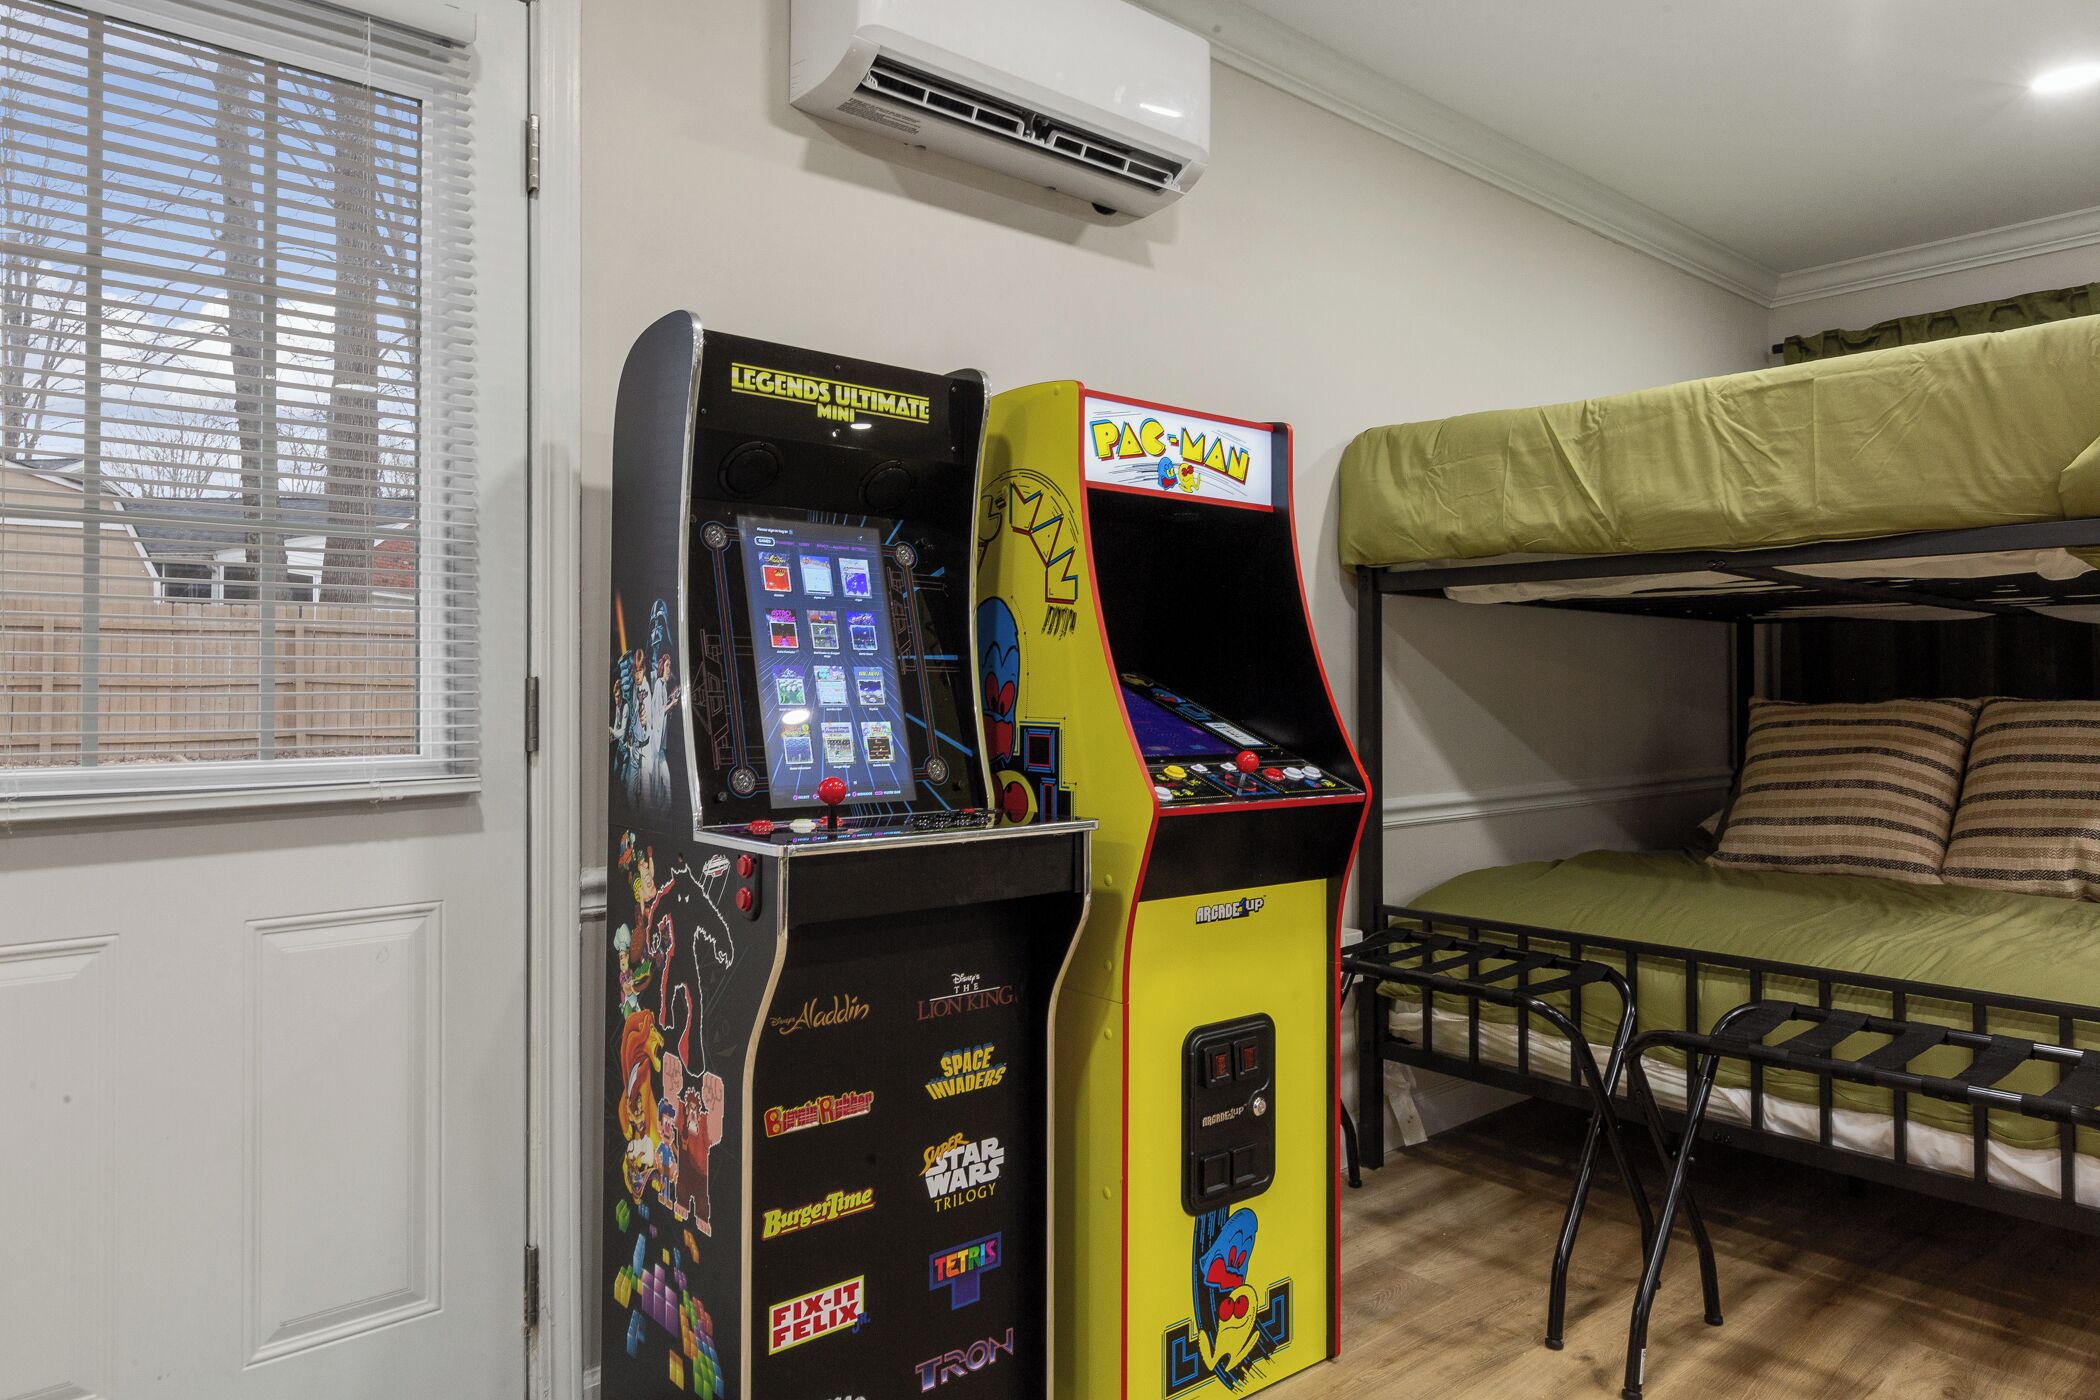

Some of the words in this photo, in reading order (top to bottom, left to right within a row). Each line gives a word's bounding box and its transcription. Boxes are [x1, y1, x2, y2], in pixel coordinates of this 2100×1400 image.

[731, 366, 830, 402] LEGENDS
[835, 384, 930, 421] ULTIMATE
[816, 403, 856, 423] MINI
[1090, 417, 1251, 485] PAC-MAN
[917, 996, 963, 1021] LION
[966, 985, 1014, 1012] KING
[953, 982, 980, 994] THE
[779, 993, 870, 1035] Aladdin
[940, 1042, 995, 1078] SPACE
[925, 1063, 1007, 1101] INVADERS
[925, 1136, 1005, 1177] STAR
[925, 1155, 1005, 1199] WARS
[934, 1182, 997, 1213] TRILOGY
[934, 1239, 998, 1282] TETRIS
[772, 1281, 861, 1328] FIX-IT
[772, 1301, 860, 1349] FELIX
[915, 1327, 1015, 1393] TRON
